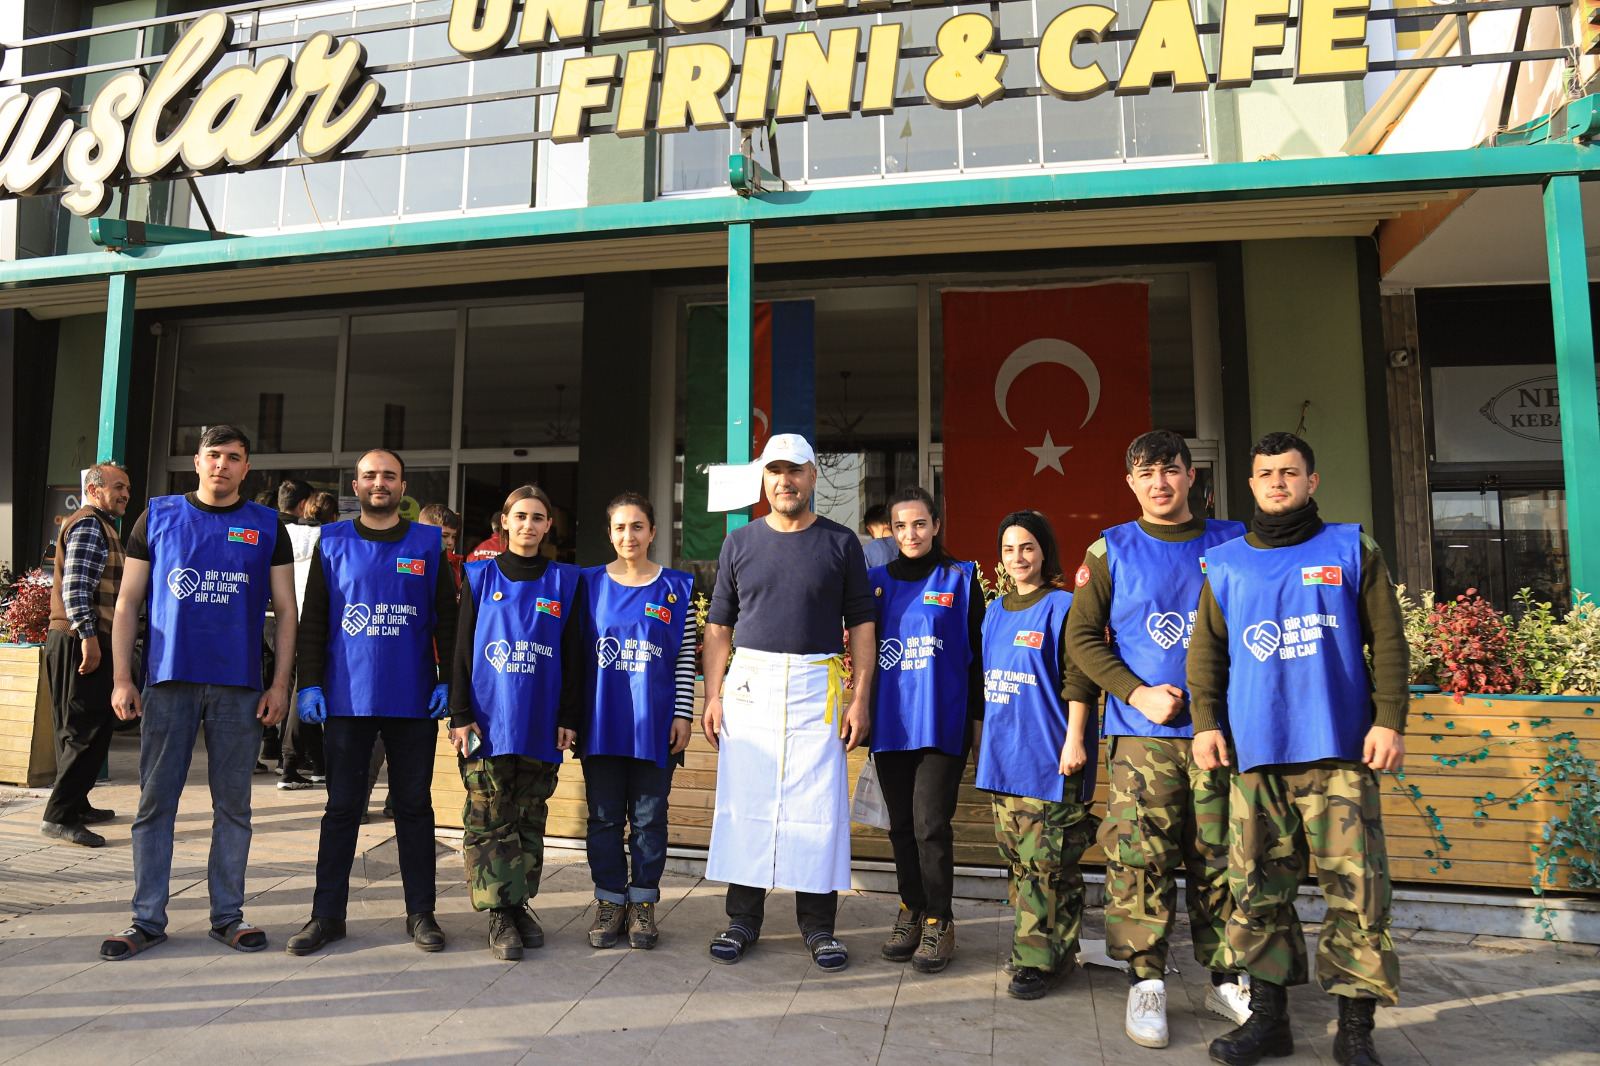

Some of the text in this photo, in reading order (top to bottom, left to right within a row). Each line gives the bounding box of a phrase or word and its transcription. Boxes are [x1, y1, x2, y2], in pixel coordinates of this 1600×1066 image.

[551, 0, 1369, 145] FIRINI & CAFE
[210, 593, 230, 605] CAN!
